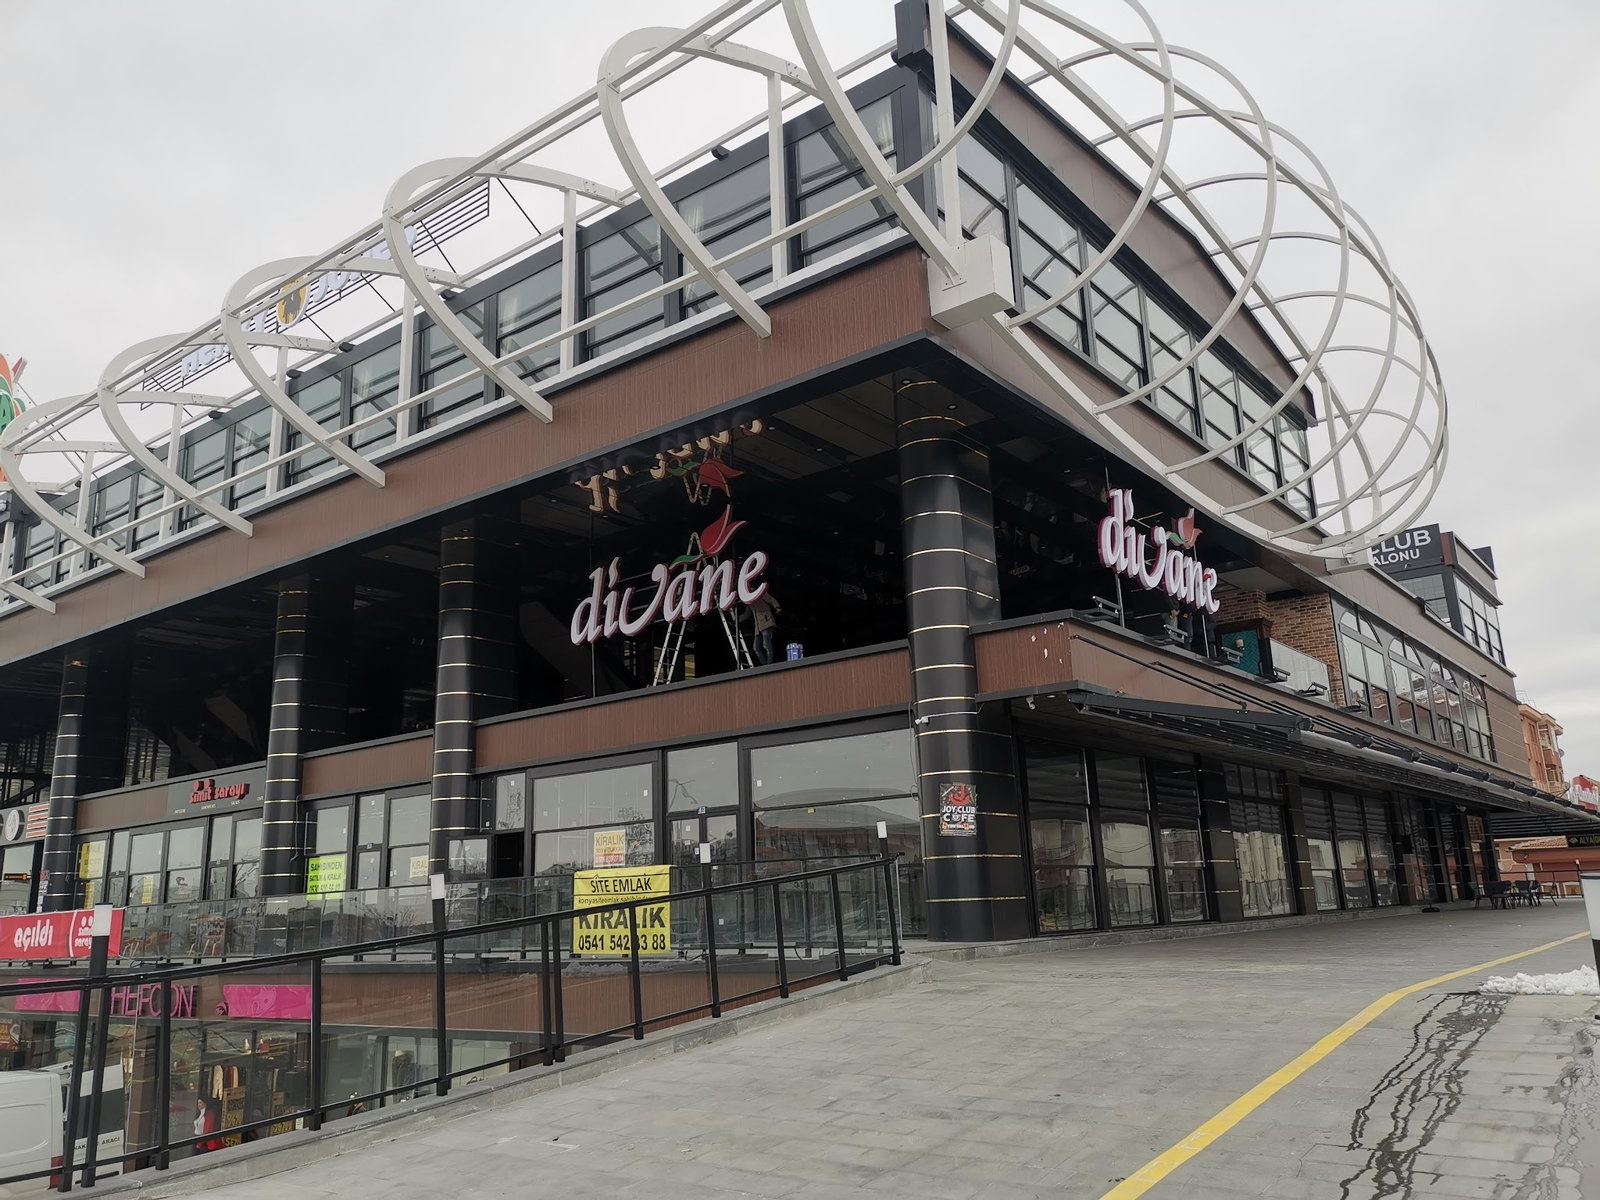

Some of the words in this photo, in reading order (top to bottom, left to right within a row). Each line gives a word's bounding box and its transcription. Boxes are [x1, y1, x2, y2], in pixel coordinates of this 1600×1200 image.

[1097, 487, 1222, 615] divane
[1373, 548, 1420, 566] ALONU
[569, 549, 769, 646] divane
[942, 805, 957, 813] JOY
[957, 806, 976, 814] CLUB
[613, 877, 652, 893] EMLAK
[14, 919, 53, 952] açıldı
[578, 934, 604, 951] 0541
[609, 934, 630, 951] 542
[652, 934, 666, 951] 88
[101, 1136, 120, 1145] ARACI
